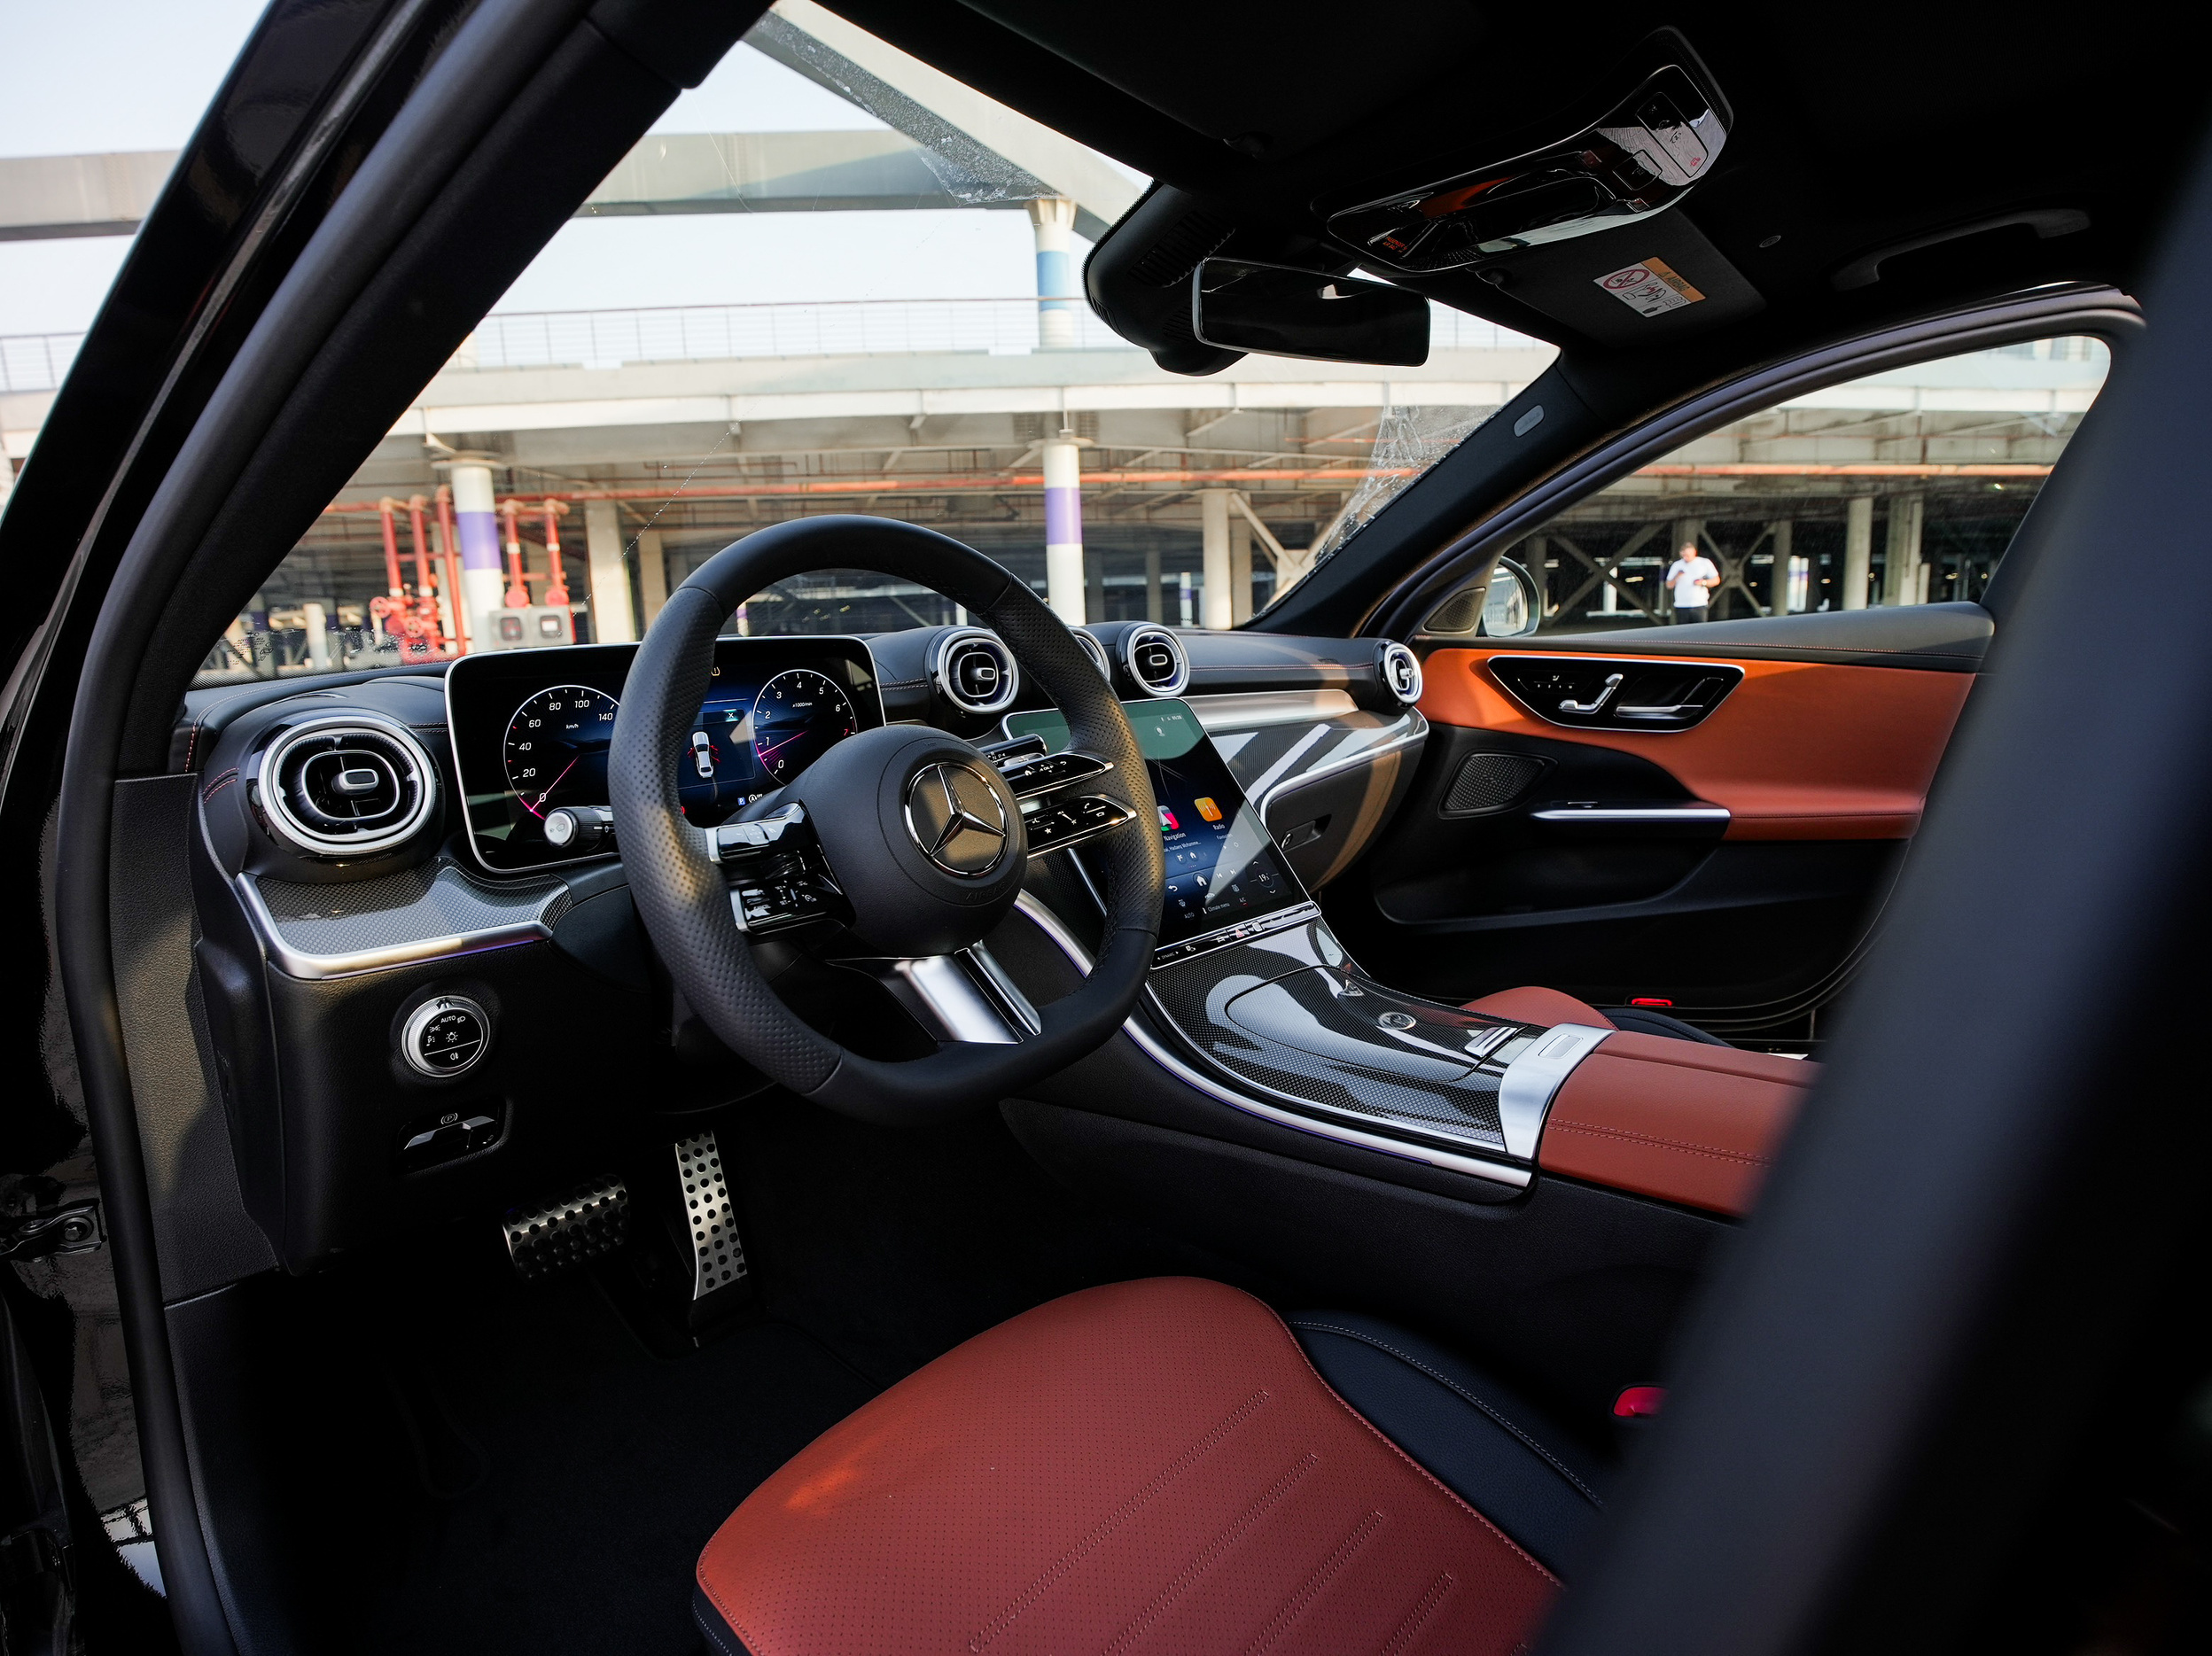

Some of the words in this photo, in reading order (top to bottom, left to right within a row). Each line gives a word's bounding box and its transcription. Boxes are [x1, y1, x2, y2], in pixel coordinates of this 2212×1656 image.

[549, 702, 562, 711] 80
[574, 699, 590, 709] 100
[835, 704, 841, 712] 6
[598, 712, 613, 721] 140
[765, 711, 771, 719] 2
[528, 719, 541, 728] 60
[766, 736, 770, 746] 1
[518, 742, 532, 751] 40
[777, 759, 784, 769] 0
[522, 767, 536, 778] 20
[539, 792, 547, 803] 0
[1164, 832, 1187, 841] Navigation
[440, 1015, 456, 1023] AUTO
